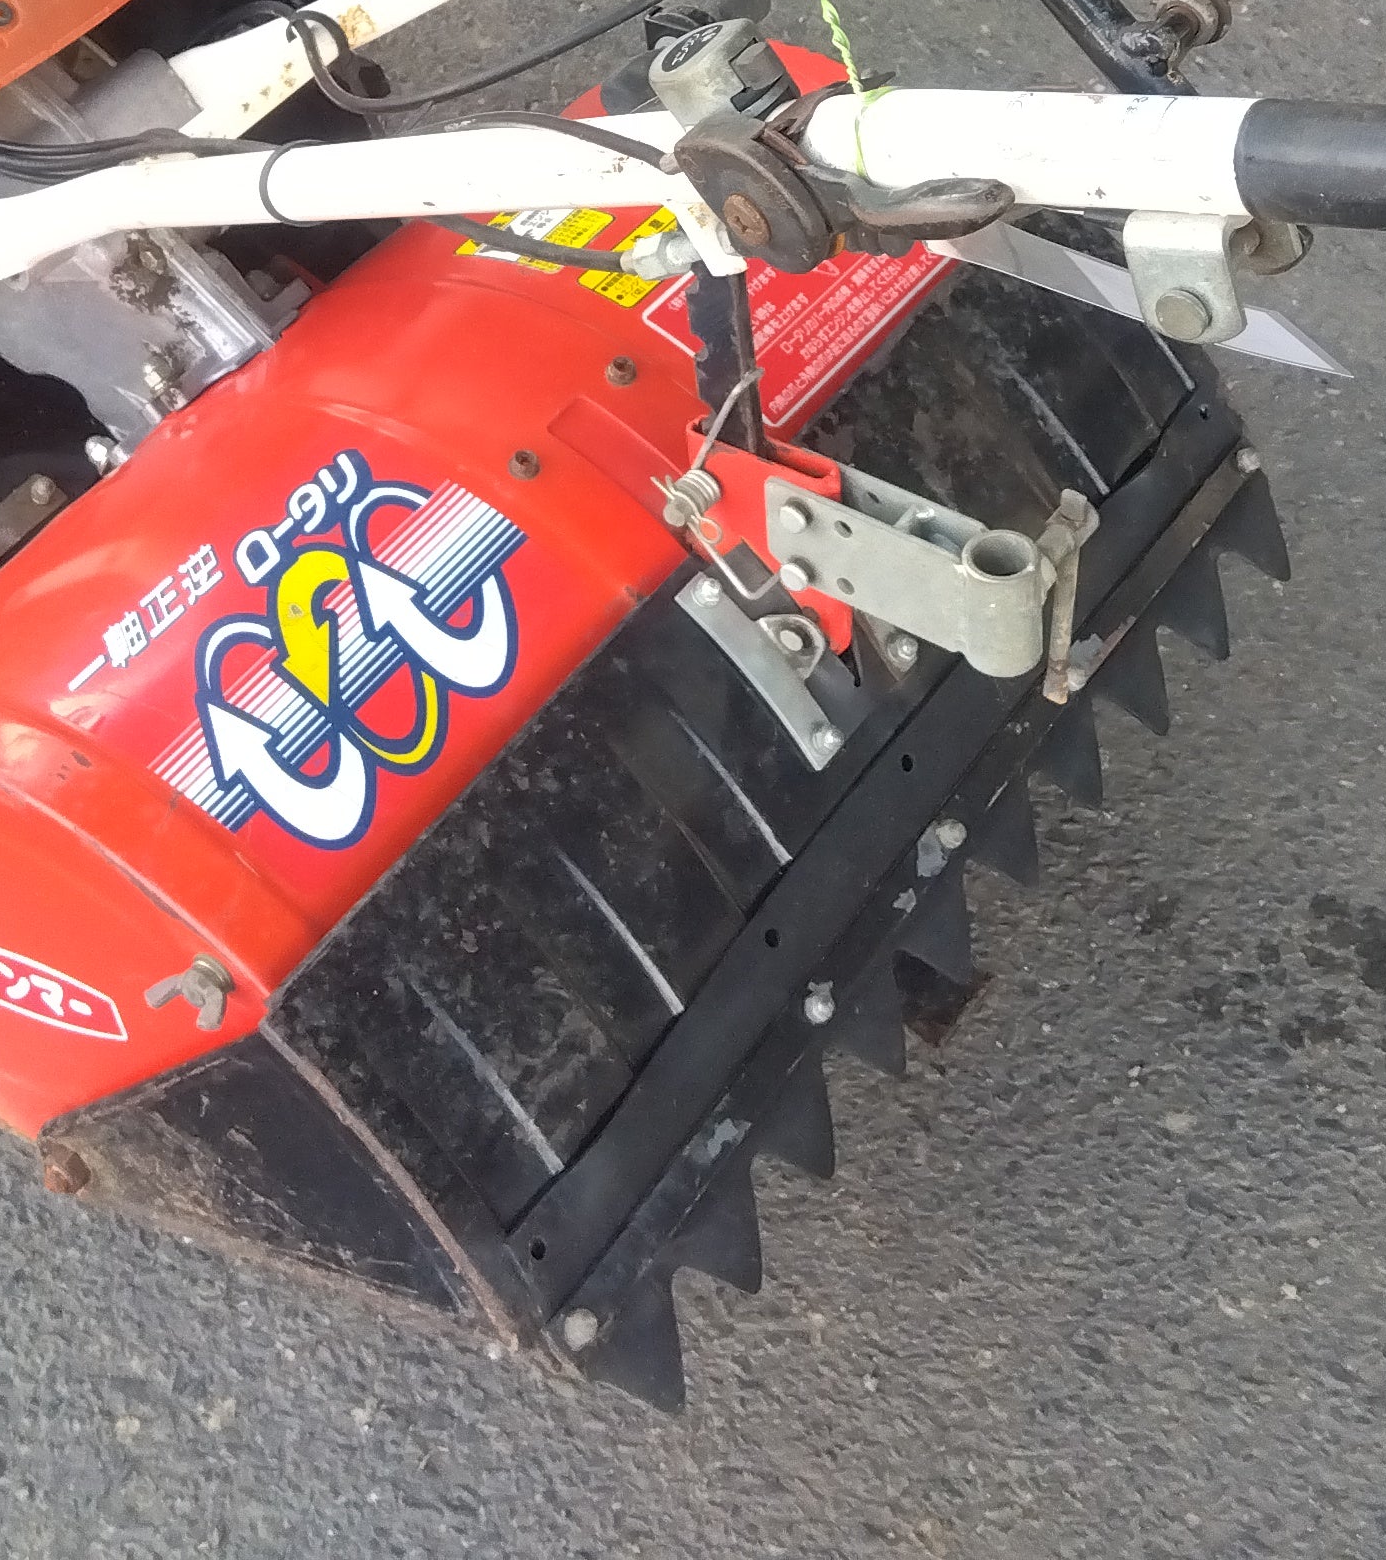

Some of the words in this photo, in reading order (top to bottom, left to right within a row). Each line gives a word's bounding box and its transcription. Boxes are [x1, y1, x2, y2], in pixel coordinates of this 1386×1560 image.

[68, 543, 224, 692] 一軸正逆
[235, 452, 358, 584] ロータリ
